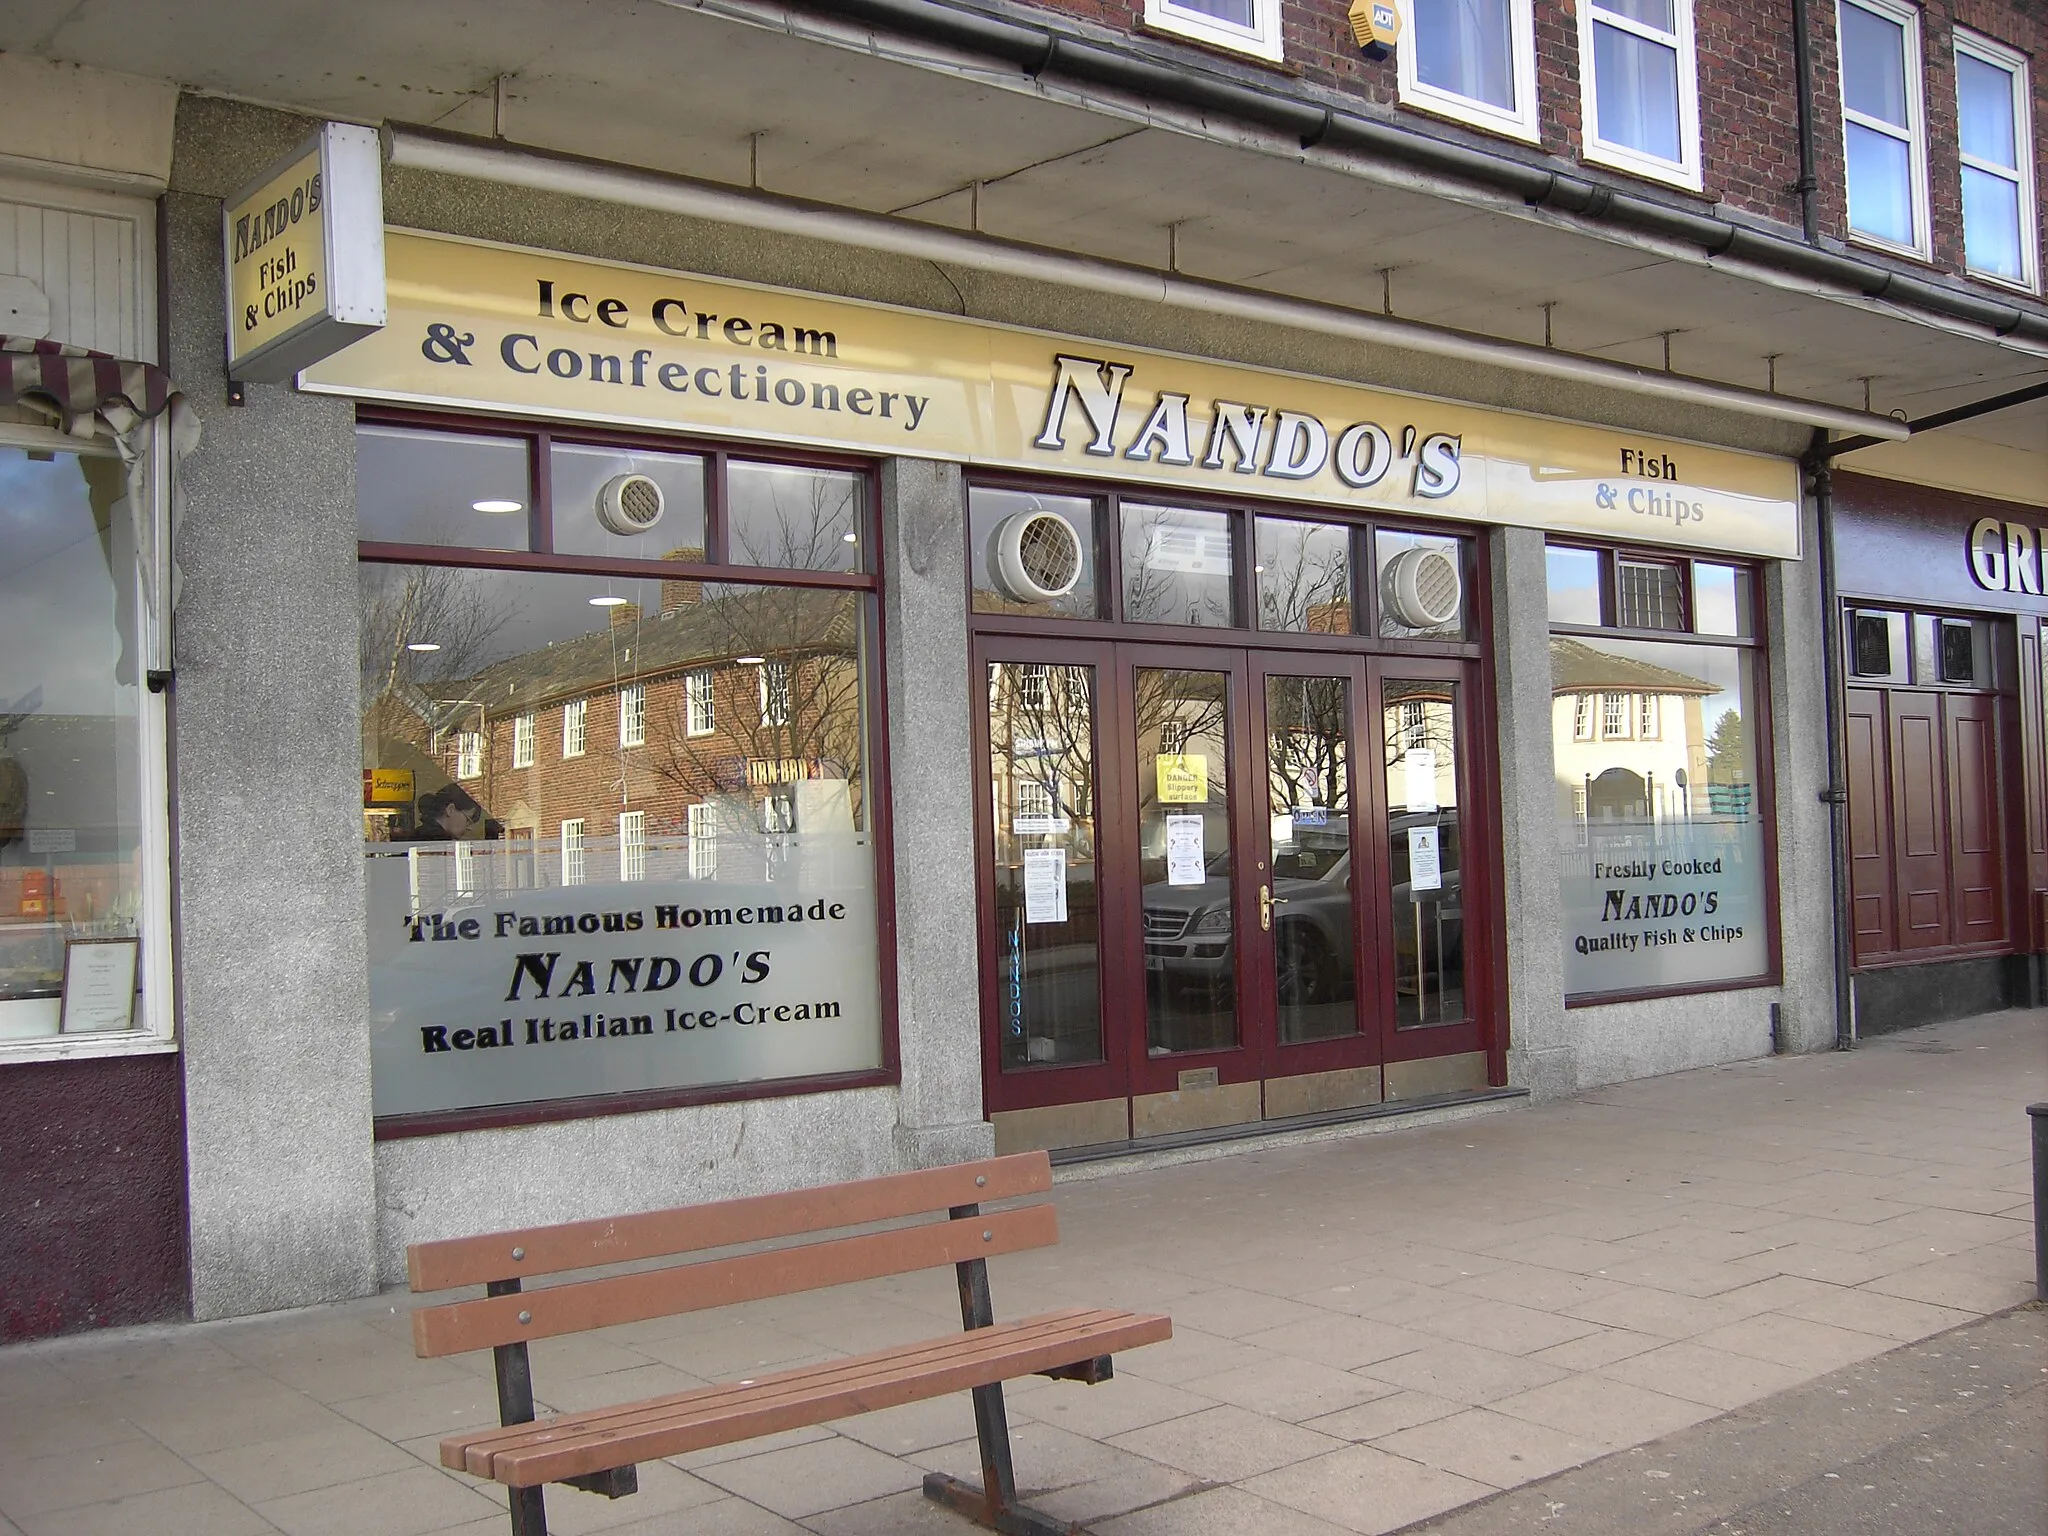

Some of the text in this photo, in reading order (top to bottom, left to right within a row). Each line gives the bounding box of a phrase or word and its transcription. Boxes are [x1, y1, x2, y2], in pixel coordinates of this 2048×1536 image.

[1373, 9, 1394, 27] ADT
[233, 173, 323, 264] NANDO'S
[259, 246, 297, 291] Fish
[245, 271, 317, 332] & Chips
[535, 278, 839, 359] Ice Cream
[420, 322, 931, 432] & Confectionery
[1033, 352, 1463, 499] NANDO'S
[1619, 447, 1678, 482] Fish
[1595, 482, 1705, 527] & Chips
[1594, 858, 1722, 881] Freshly Cooked
[402, 898, 847, 943] The Famous Homemade
[1601, 889, 1719, 922] NANDO'S
[1574, 924, 1744, 955] Quality Fish & Chips
[503, 949, 772, 1002] NANDO'S
[1008, 929, 1021, 1038] NANDOS
[420, 1000, 842, 1054] Real Italian Ice-Cream
